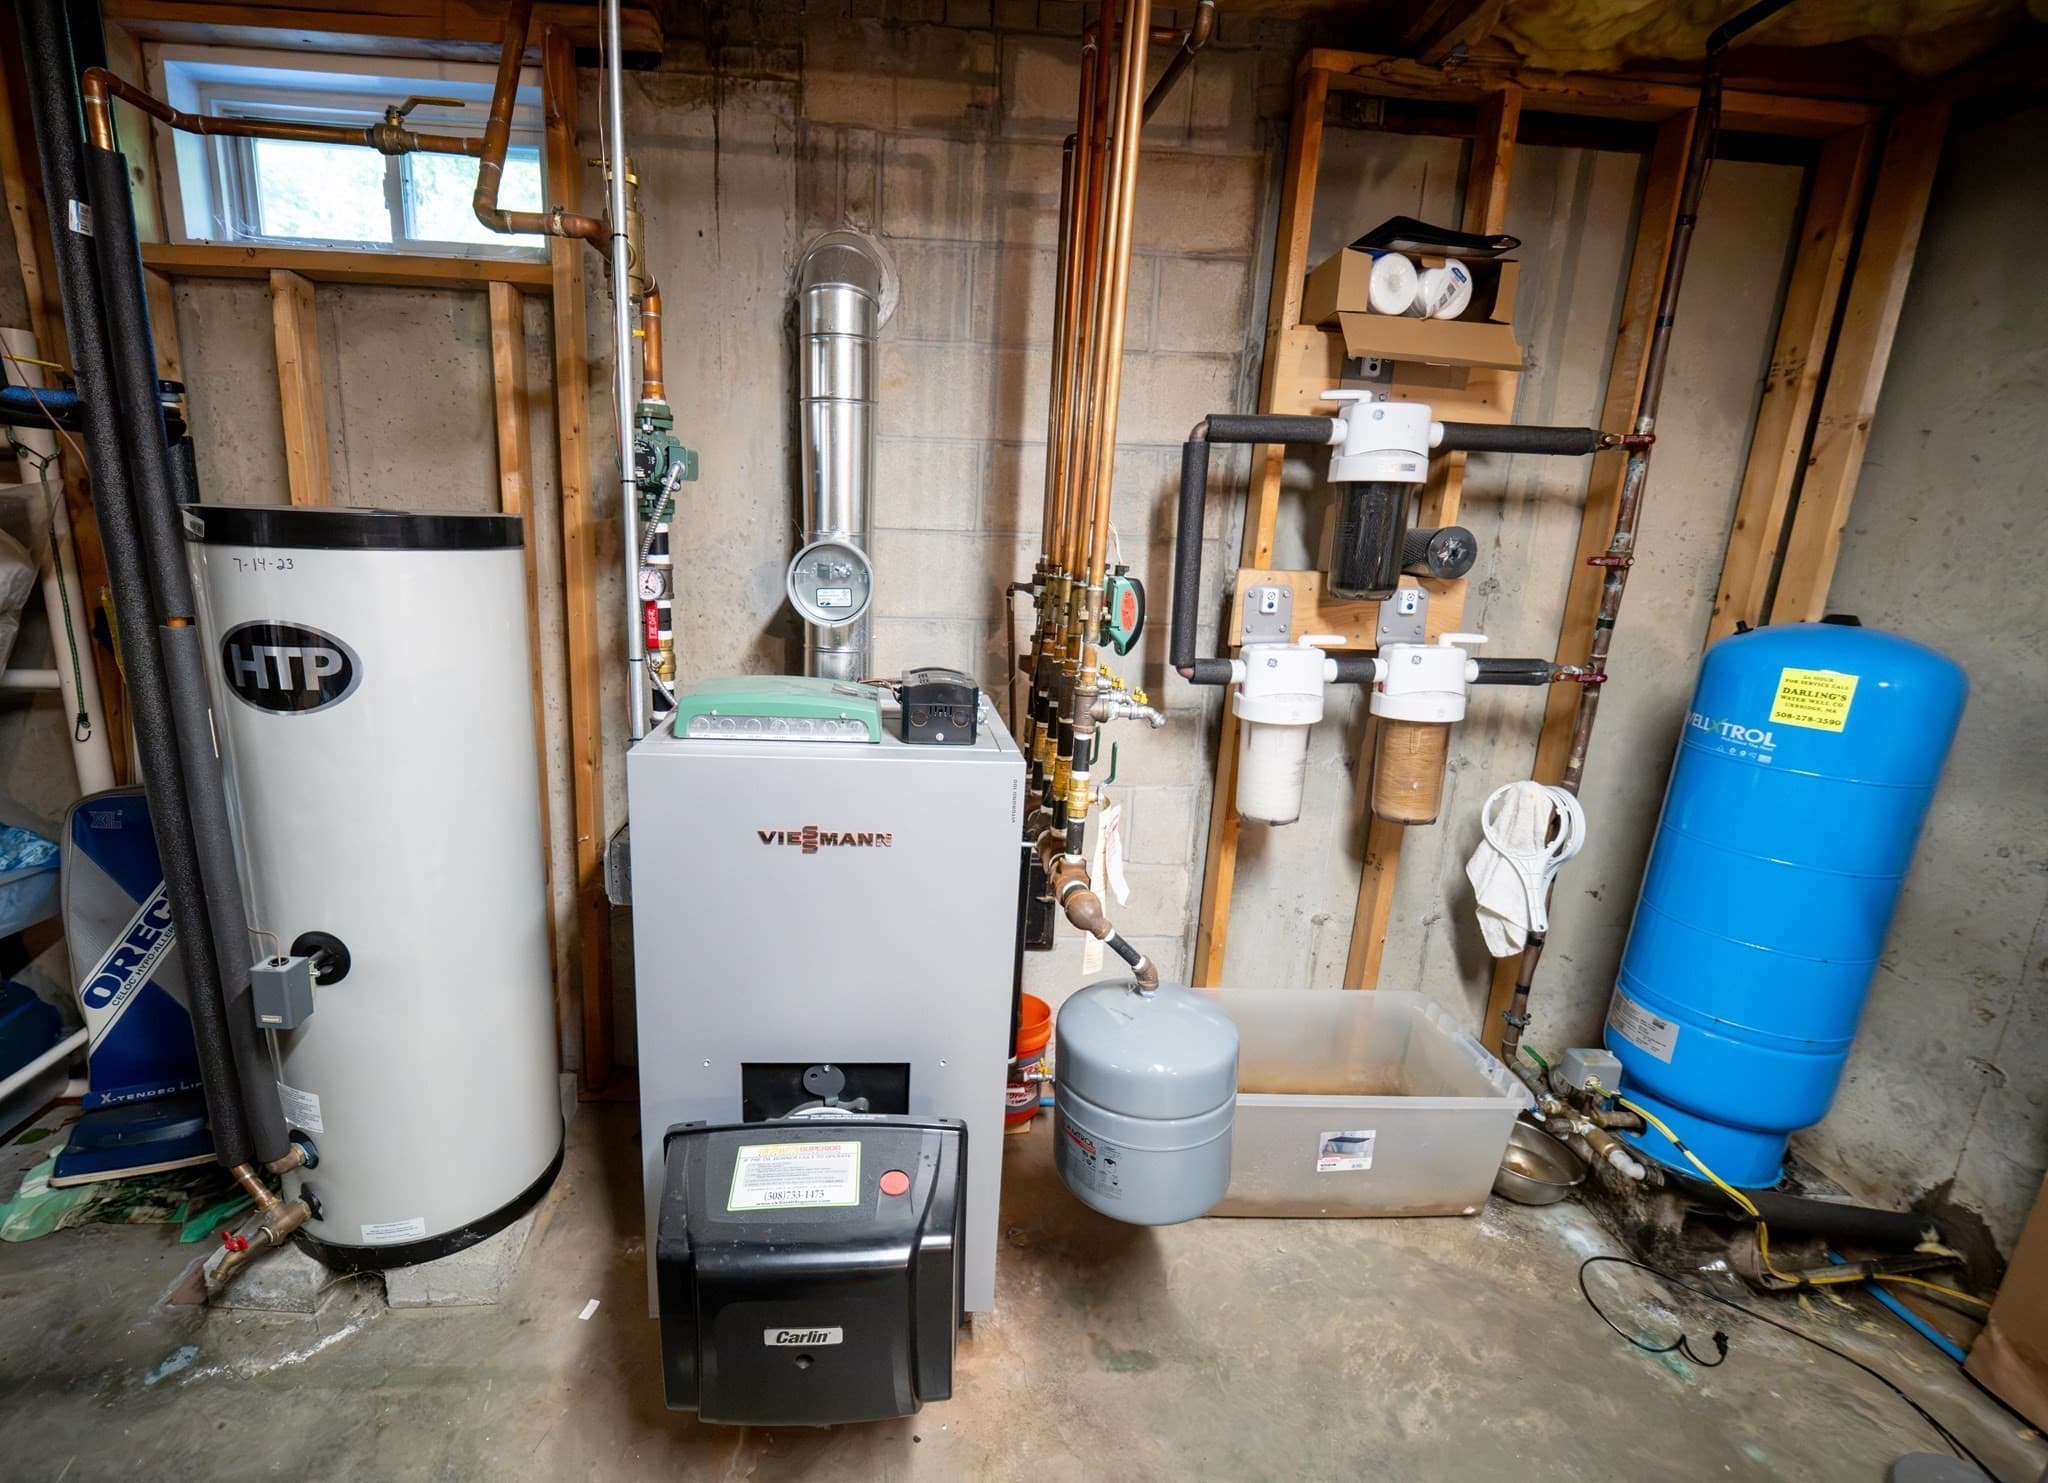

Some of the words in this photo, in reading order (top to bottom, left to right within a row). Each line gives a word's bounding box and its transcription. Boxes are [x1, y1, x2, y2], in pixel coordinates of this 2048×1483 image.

[232, 557, 295, 573] 7-14-23
[230, 642, 343, 691] HTP
[1780, 695, 1806, 703] WATER
[1782, 687, 1847, 702] DARLING'S
[757, 825, 893, 854] VIESSMANN
[83, 890, 173, 1010] OREC
[135, 923, 176, 977] HYPO-ALLER
[180, 1081, 203, 1091] LIF
[776, 1331, 829, 1344] Carlin
